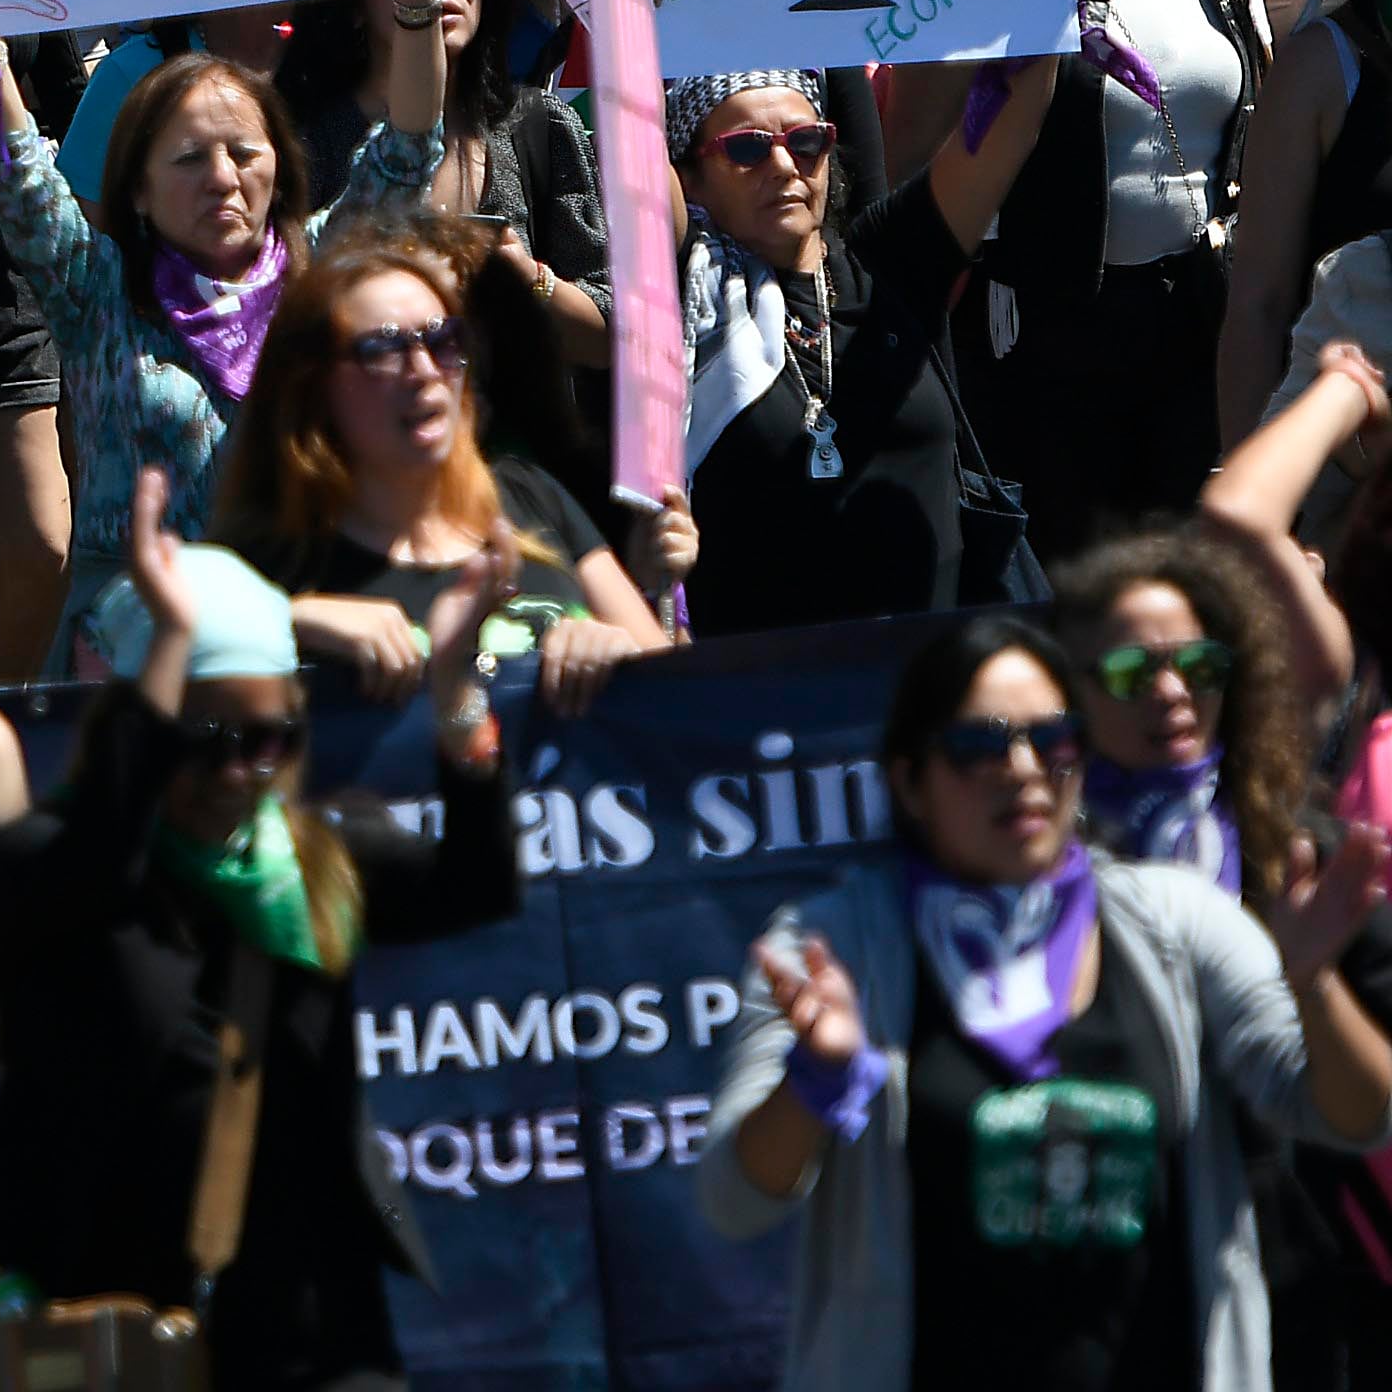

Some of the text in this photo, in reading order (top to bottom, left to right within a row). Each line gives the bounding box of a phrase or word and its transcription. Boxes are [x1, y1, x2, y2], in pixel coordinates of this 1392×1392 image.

[689, 731, 894, 858] sin
[354, 984, 671, 1080] HAMOS
[605, 1095, 712, 1174] DE
